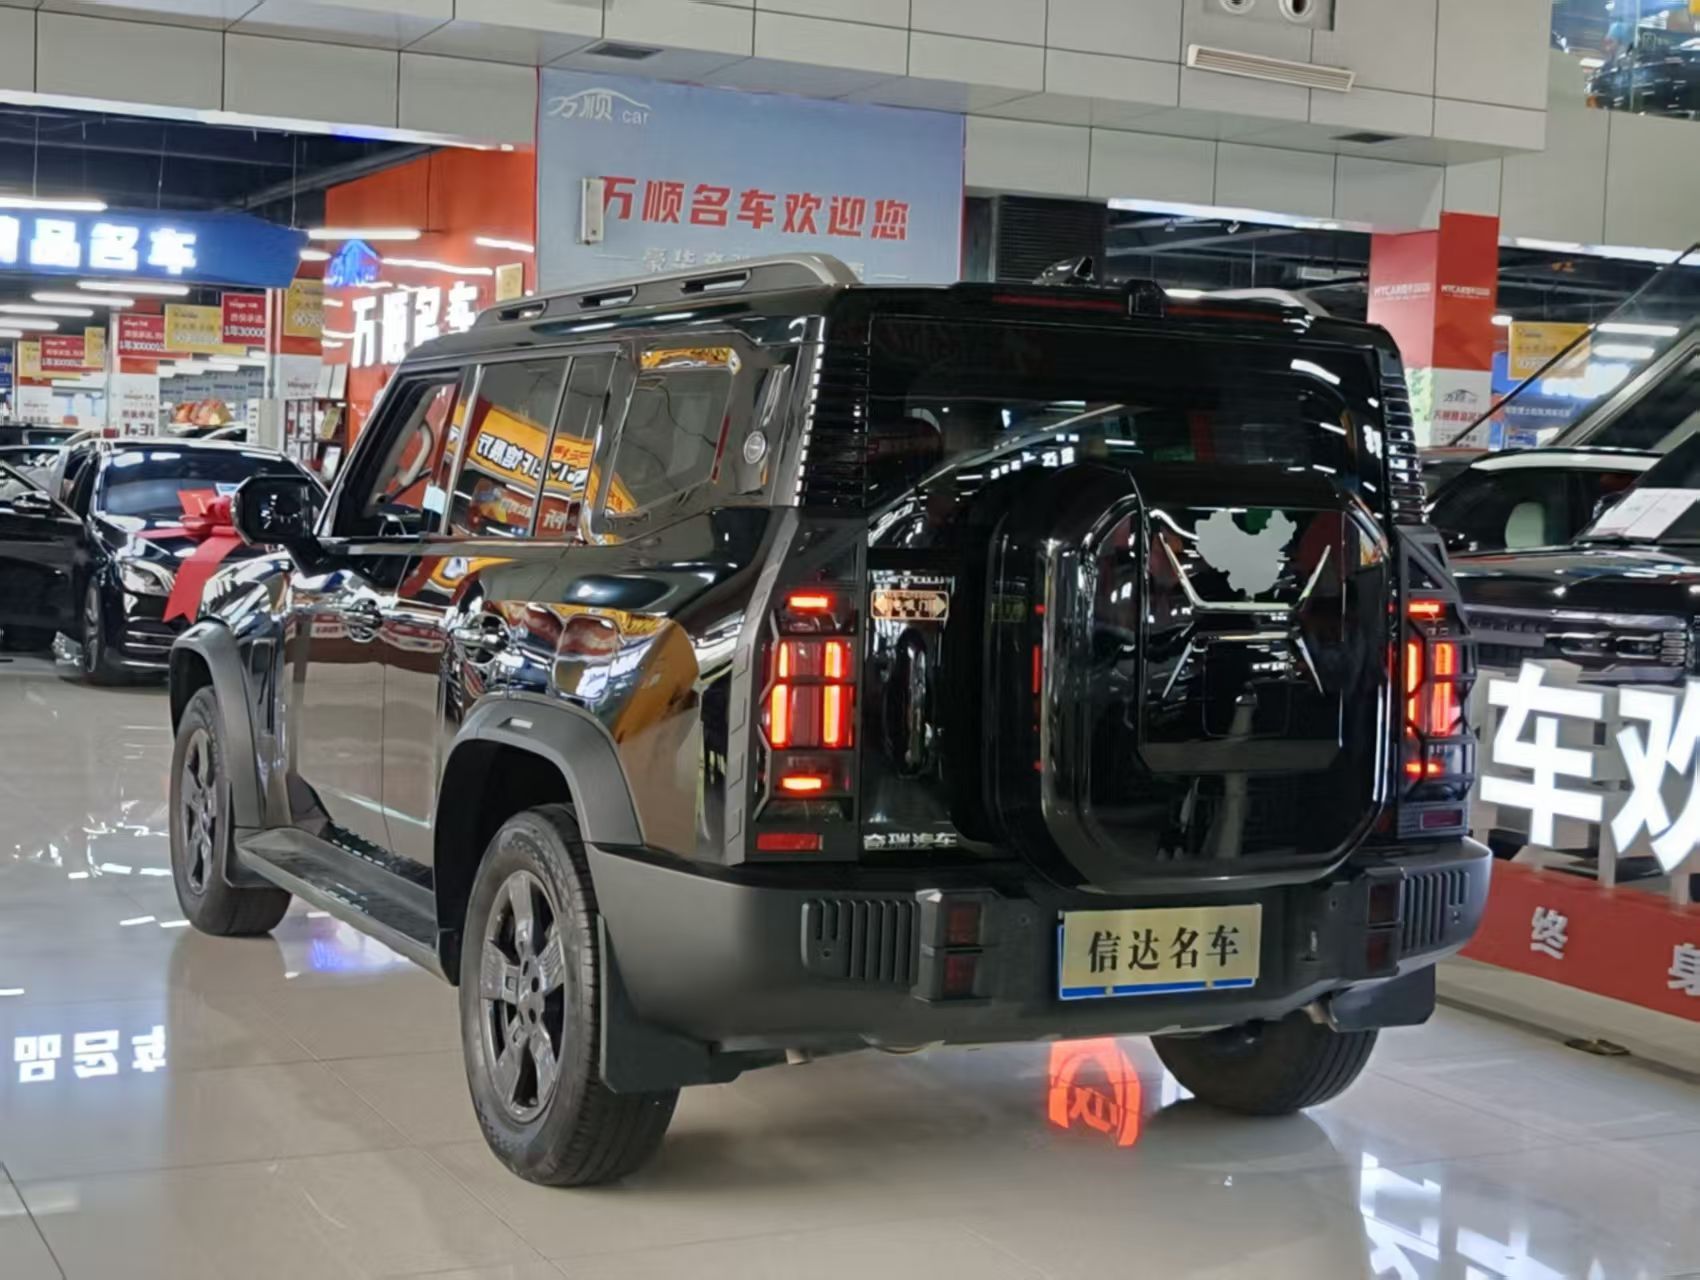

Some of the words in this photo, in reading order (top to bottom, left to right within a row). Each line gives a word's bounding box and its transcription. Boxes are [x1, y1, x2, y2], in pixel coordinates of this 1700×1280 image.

[622, 110, 650, 125] car
[600, 175, 909, 241] 万顺名车欢迎您
[863, 832, 957, 851] 奇瑞汽车
[1087, 924, 1240, 974] 信达名车
